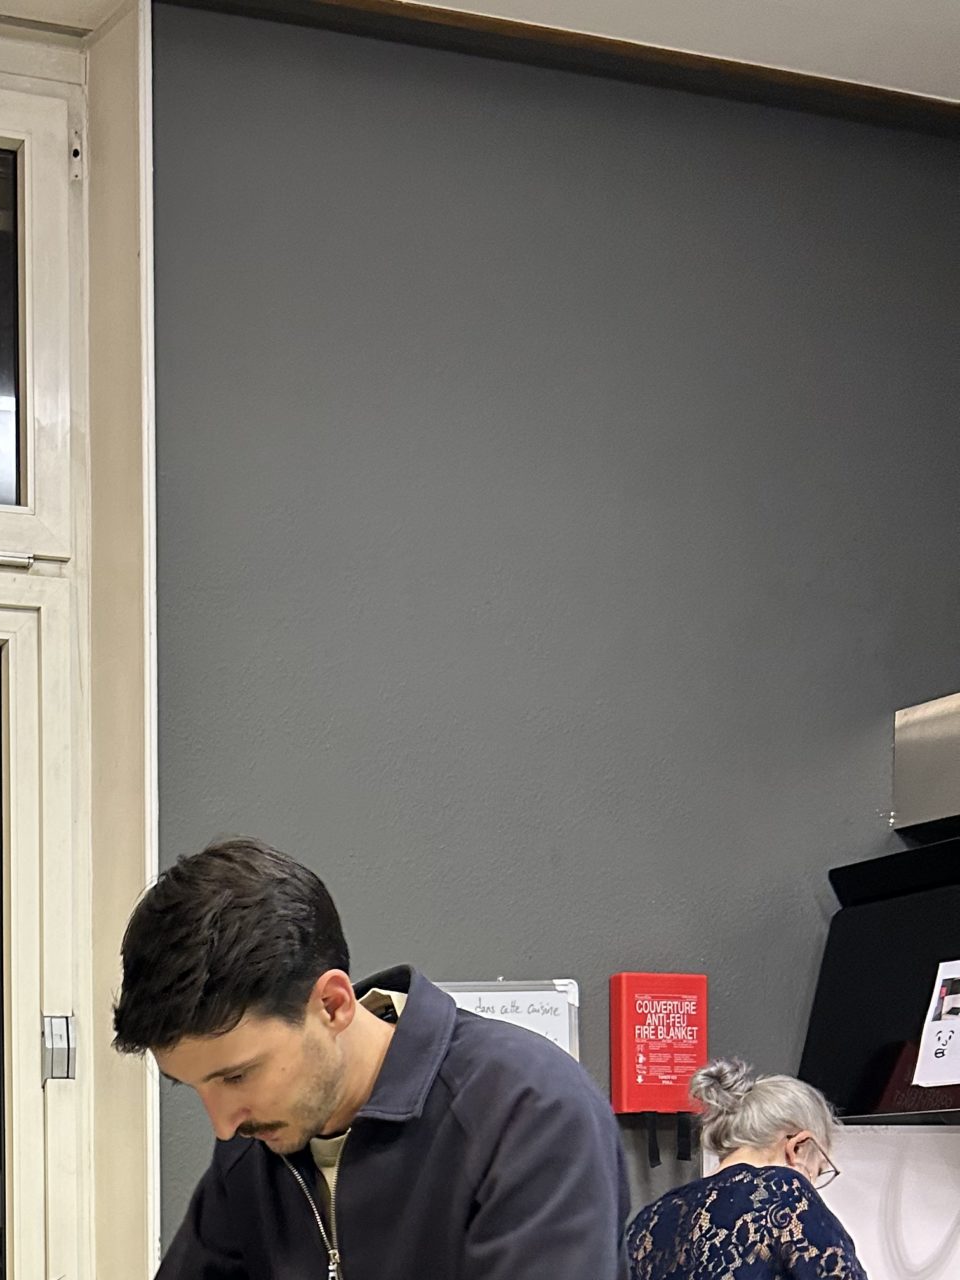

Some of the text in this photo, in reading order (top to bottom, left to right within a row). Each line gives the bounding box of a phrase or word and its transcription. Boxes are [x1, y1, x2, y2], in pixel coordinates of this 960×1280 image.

[475, 997, 495, 1014] dans
[636, 1000, 696, 1014] COUVERTURE
[646, 1013, 687, 1027] ANTI-FEU
[635, 1025, 698, 1039] FIRE BLANKET
